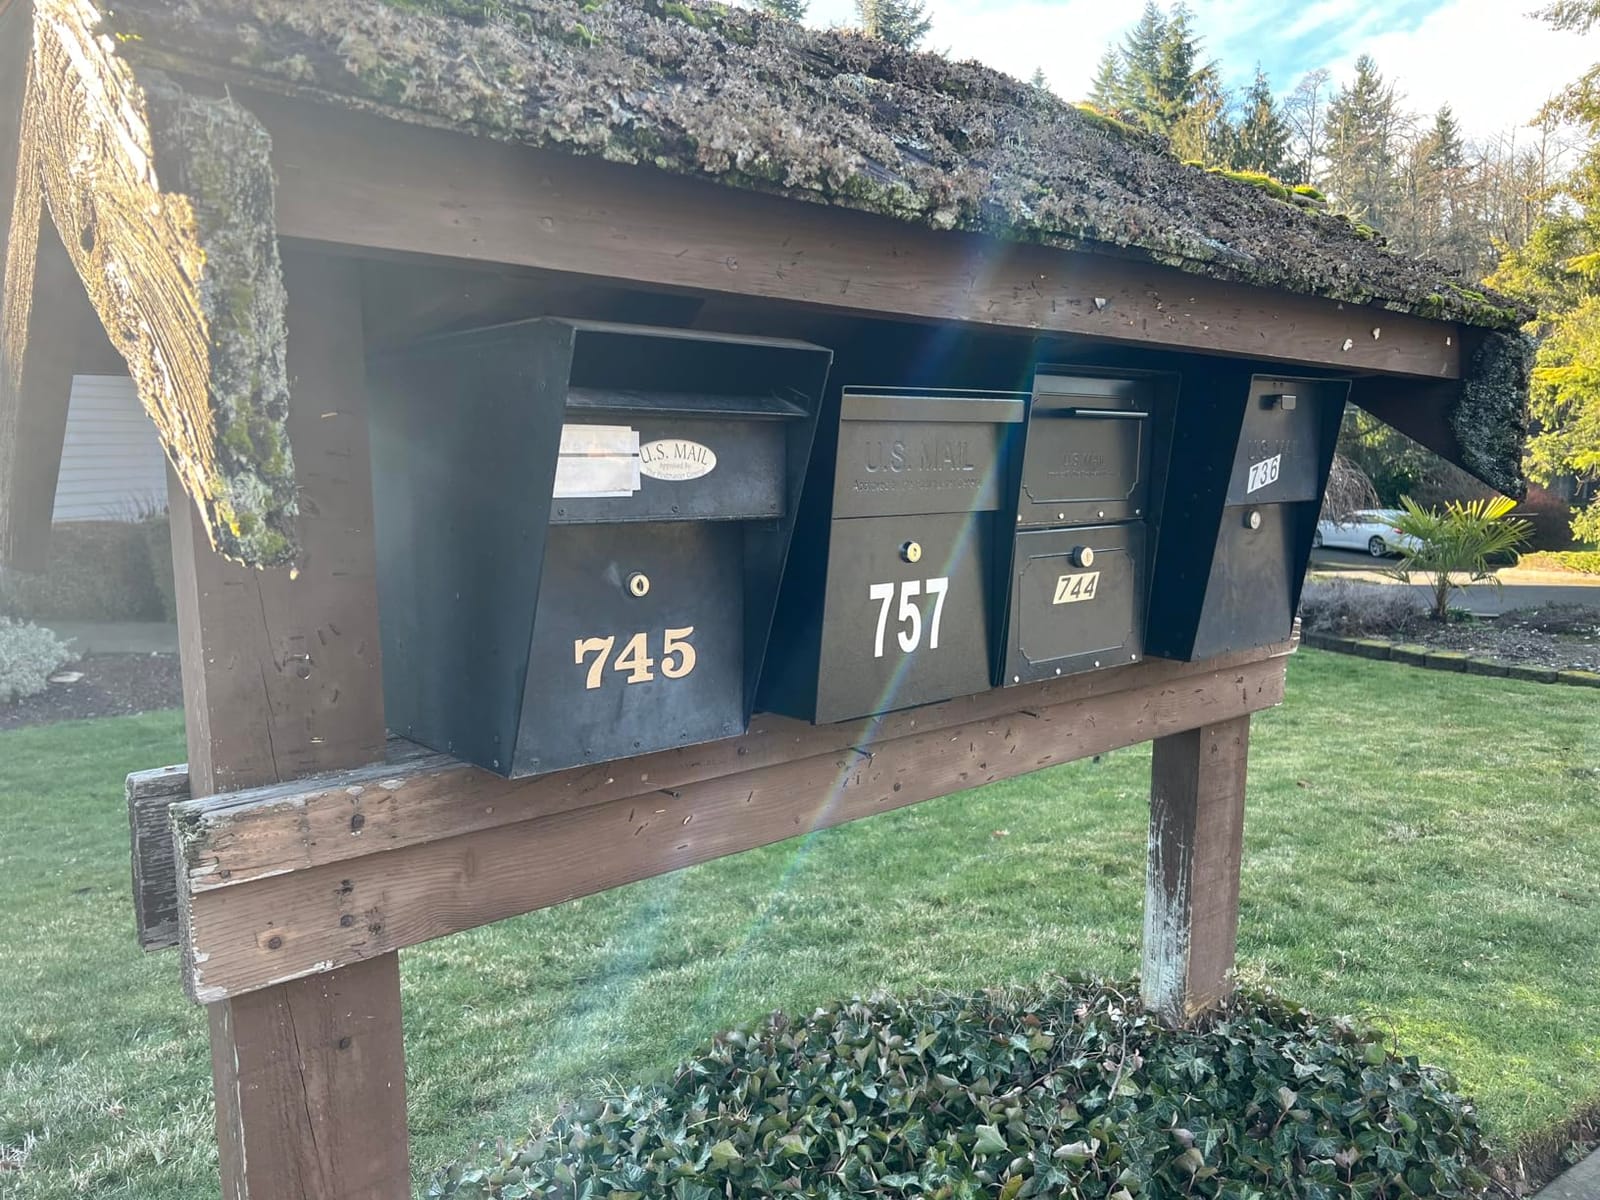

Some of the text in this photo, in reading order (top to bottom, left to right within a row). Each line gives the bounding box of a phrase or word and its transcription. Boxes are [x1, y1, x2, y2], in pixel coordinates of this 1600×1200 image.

[640, 443, 708, 466] U.S. MAIL
[863, 438, 976, 473] U.S. MAIL
[1250, 459, 1278, 490] 736
[1058, 574, 1097, 601] 744
[869, 576, 949, 658] 757
[573, 626, 697, 690] 745
